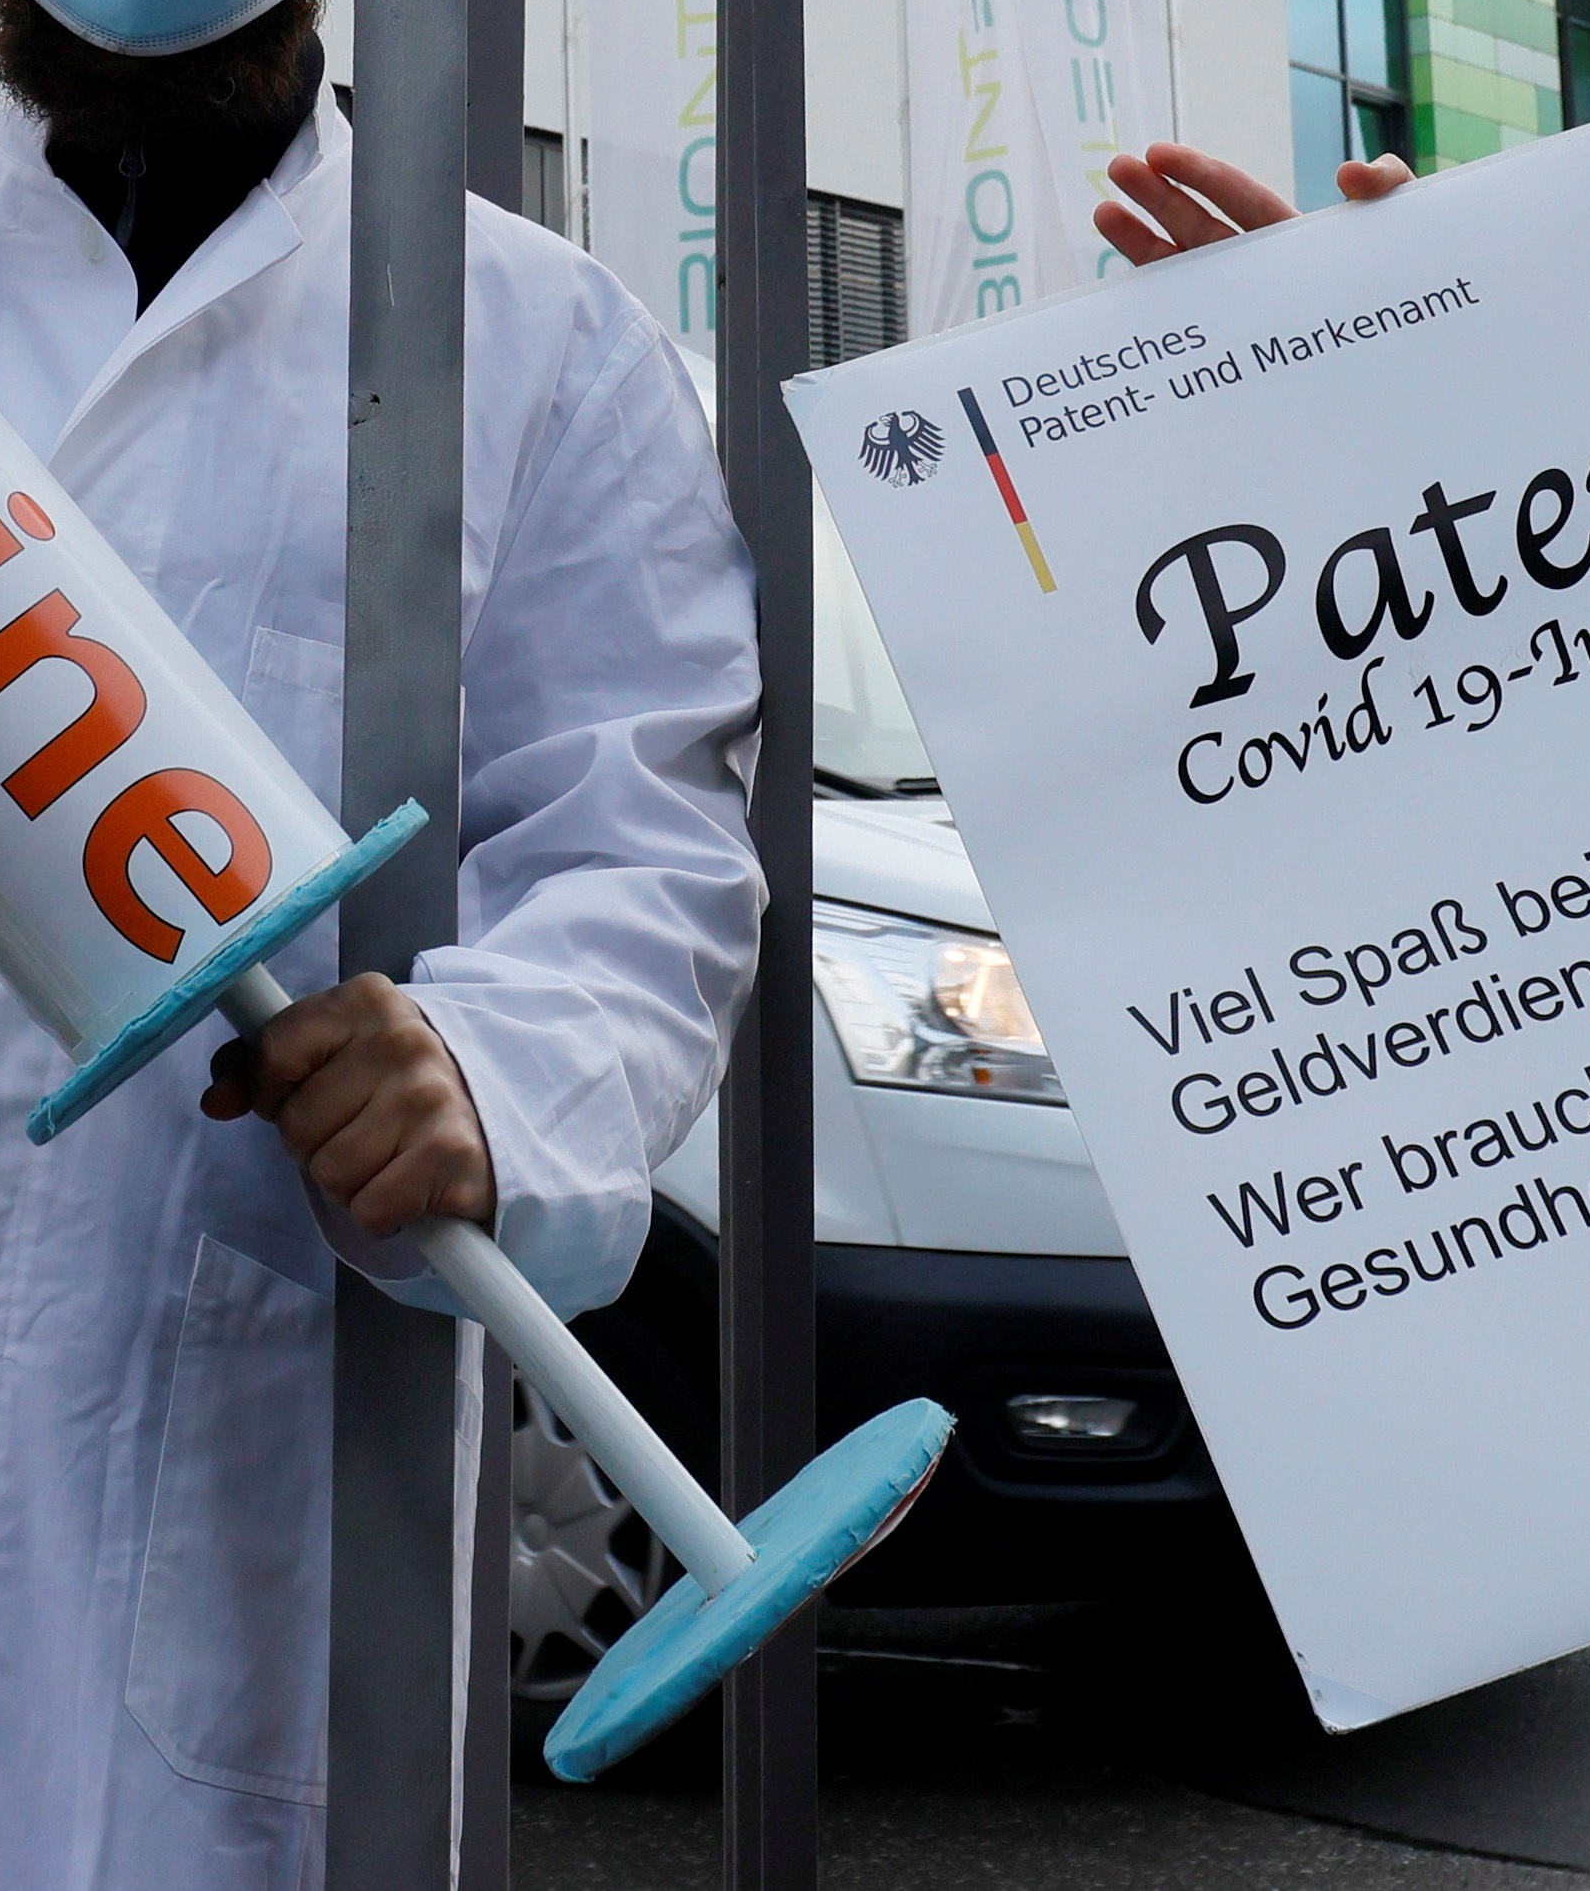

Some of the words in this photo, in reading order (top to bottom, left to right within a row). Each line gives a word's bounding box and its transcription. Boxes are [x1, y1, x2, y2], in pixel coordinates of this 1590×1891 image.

[1001, 325, 1207, 408] Deutsches
[1019, 385, 1156, 448] Patent-
[1168, 350, 1243, 400] und
[1250, 278, 1481, 373] Markenamt
[1177, 656, 1393, 805] Covid
[1126, 966, 1276, 1056] Viel
[1289, 899, 1488, 1007] Spaß
[1206, 1162, 1364, 1249] Wer
